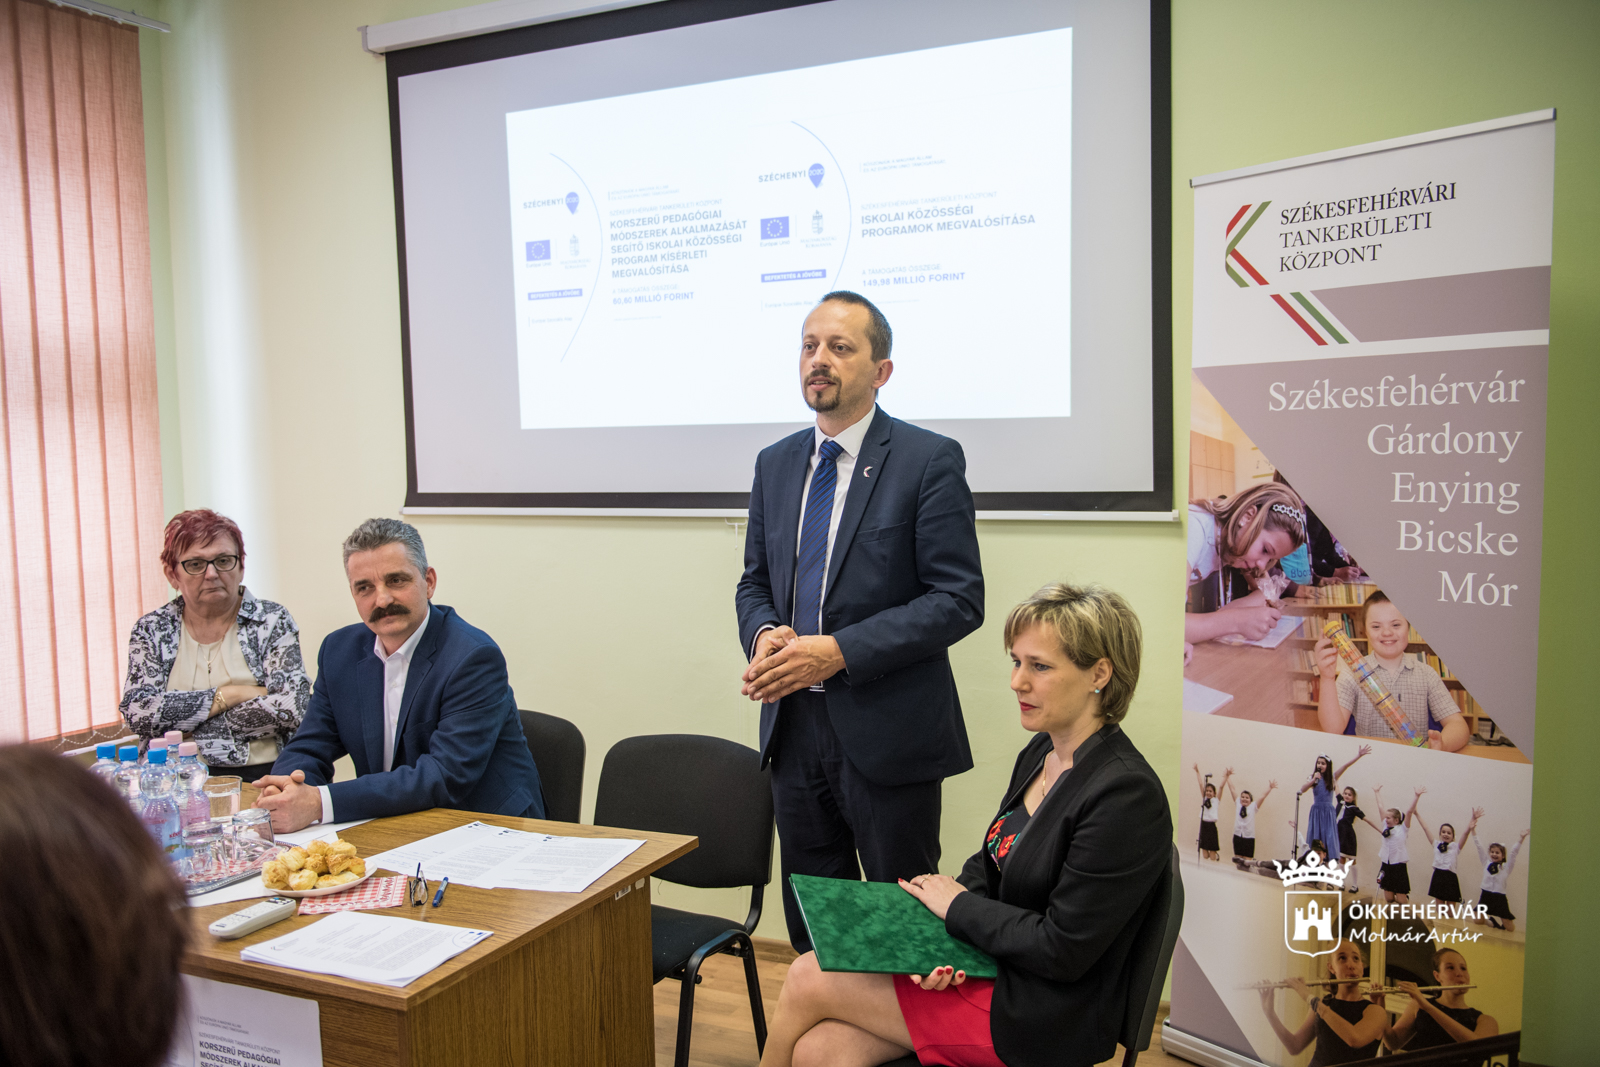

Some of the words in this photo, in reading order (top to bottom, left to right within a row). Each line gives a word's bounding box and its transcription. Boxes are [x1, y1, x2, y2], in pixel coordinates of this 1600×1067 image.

[758, 170, 806, 182] SZÉCHENYI
[523, 198, 564, 209] SZÉCHENYI
[862, 212, 904, 224] ISKOLAI
[908, 204, 974, 220] KÖZÖSSÉGI
[1280, 182, 1457, 226] SZÉKESFEHÉRVÁRI
[610, 214, 660, 229] KORSZERŰ
[662, 210, 722, 224] PEDAGÓGIAI
[862, 222, 934, 238] PROGRAMOK
[937, 213, 1036, 231] MEGVALÓSÍTÁSA
[1279, 210, 1433, 249] TANKERÜLETI
[610, 226, 668, 242] MÓDSZEREK
[670, 220, 747, 236] ALKALMAZÁSÁT
[611, 241, 644, 254] SEGÍTŐ
[646, 239, 683, 250] ISKOLAI
[686, 233, 742, 247] KÖZÖSSÉGI
[612, 254, 658, 266] PROGRAM
[660, 249, 708, 262] KÍSÉRLETI
[1279, 243, 1382, 273] KÖZPONT
[612, 263, 689, 278] MEGVALÓSÍTÁSA
[862, 278, 890, 287] 149,98
[893, 274, 926, 285] MILLIÓ
[928, 272, 966, 282] FORINT
[634, 293, 662, 304] MILLIÓ
[664, 292, 694, 301] FORINT
[1269, 370, 1526, 411] Székesfehérvár
[1367, 423, 1523, 463] Gárdony
[1392, 472, 1520, 514] Enying
[1397, 520, 1518, 556] Bicske
[1438, 570, 1518, 606] Mór
[199, 1041, 236, 1056] KORSZERŰ
[237, 1050, 281, 1066] PEDAGÓGIAI
[200, 1051, 241, 1067] MÓDSZEREK
